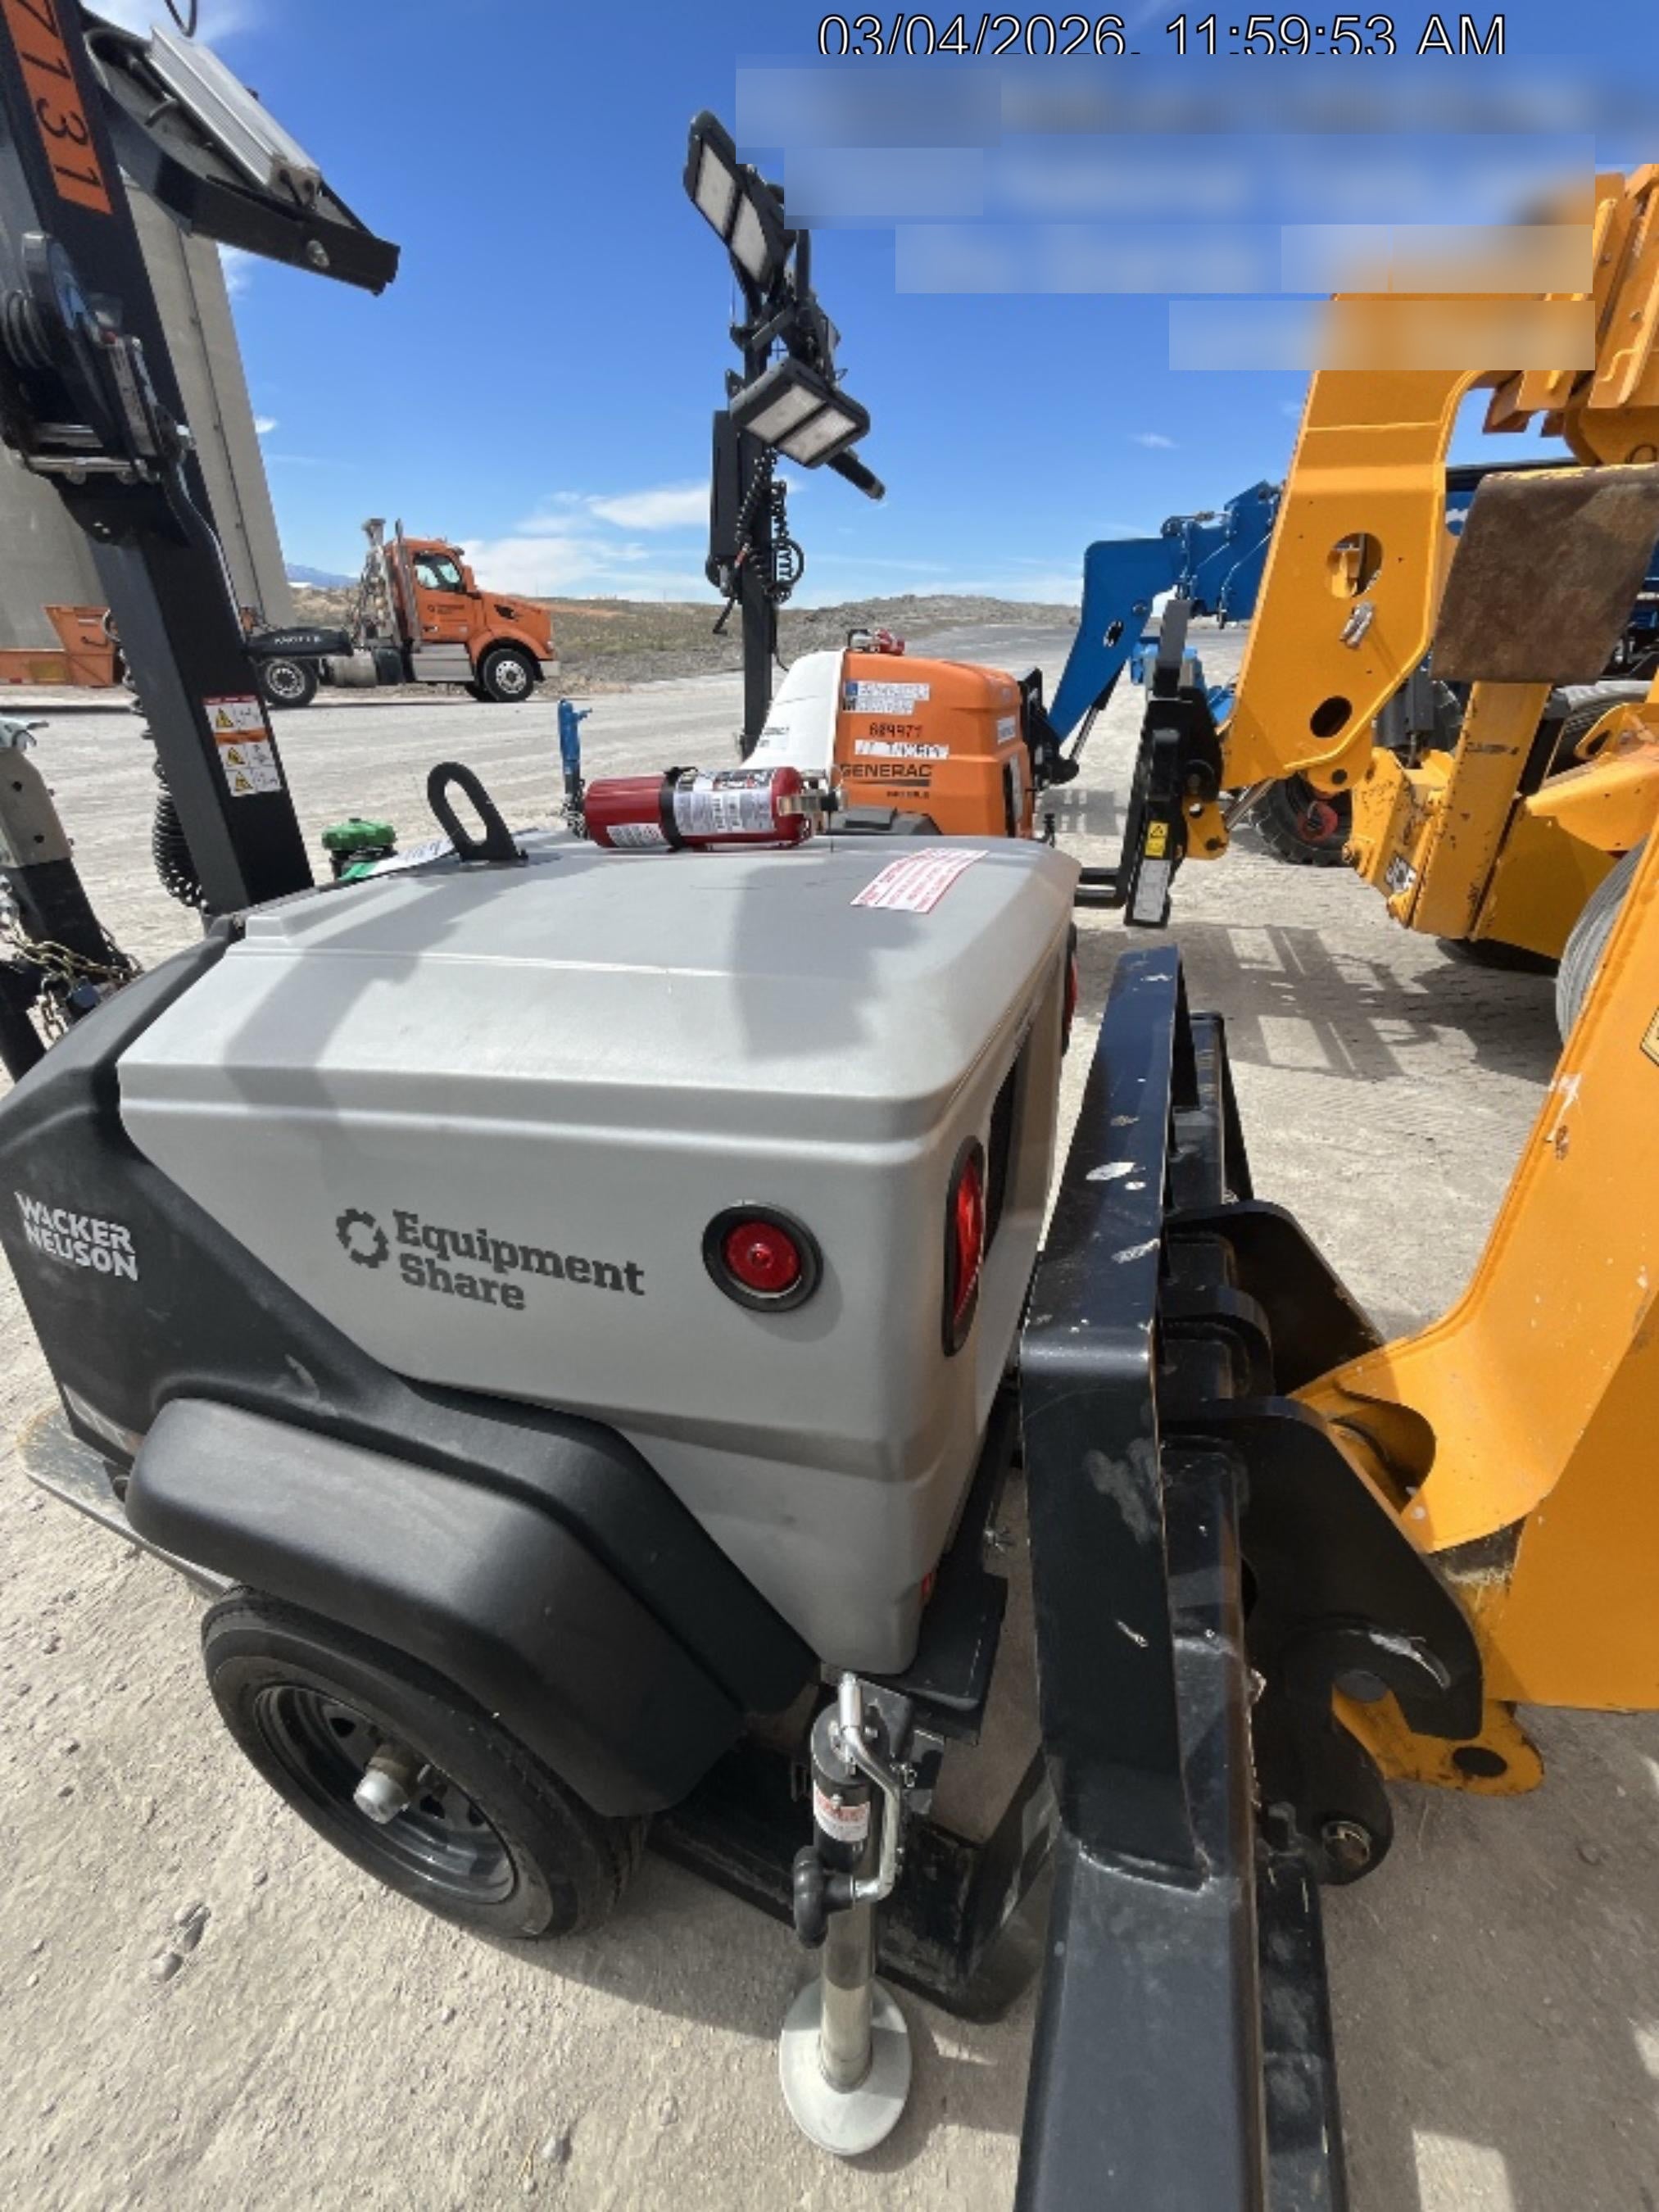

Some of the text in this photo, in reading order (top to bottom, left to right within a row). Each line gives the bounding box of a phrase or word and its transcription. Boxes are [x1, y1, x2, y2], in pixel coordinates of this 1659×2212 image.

[840, 764, 932, 777] GENERAC
[13, 1190, 136, 1253] WACKER
[23, 1217, 138, 1281] NEUSON
[392, 1208, 646, 1296] Equipment
[399, 1253, 527, 1312] Share
